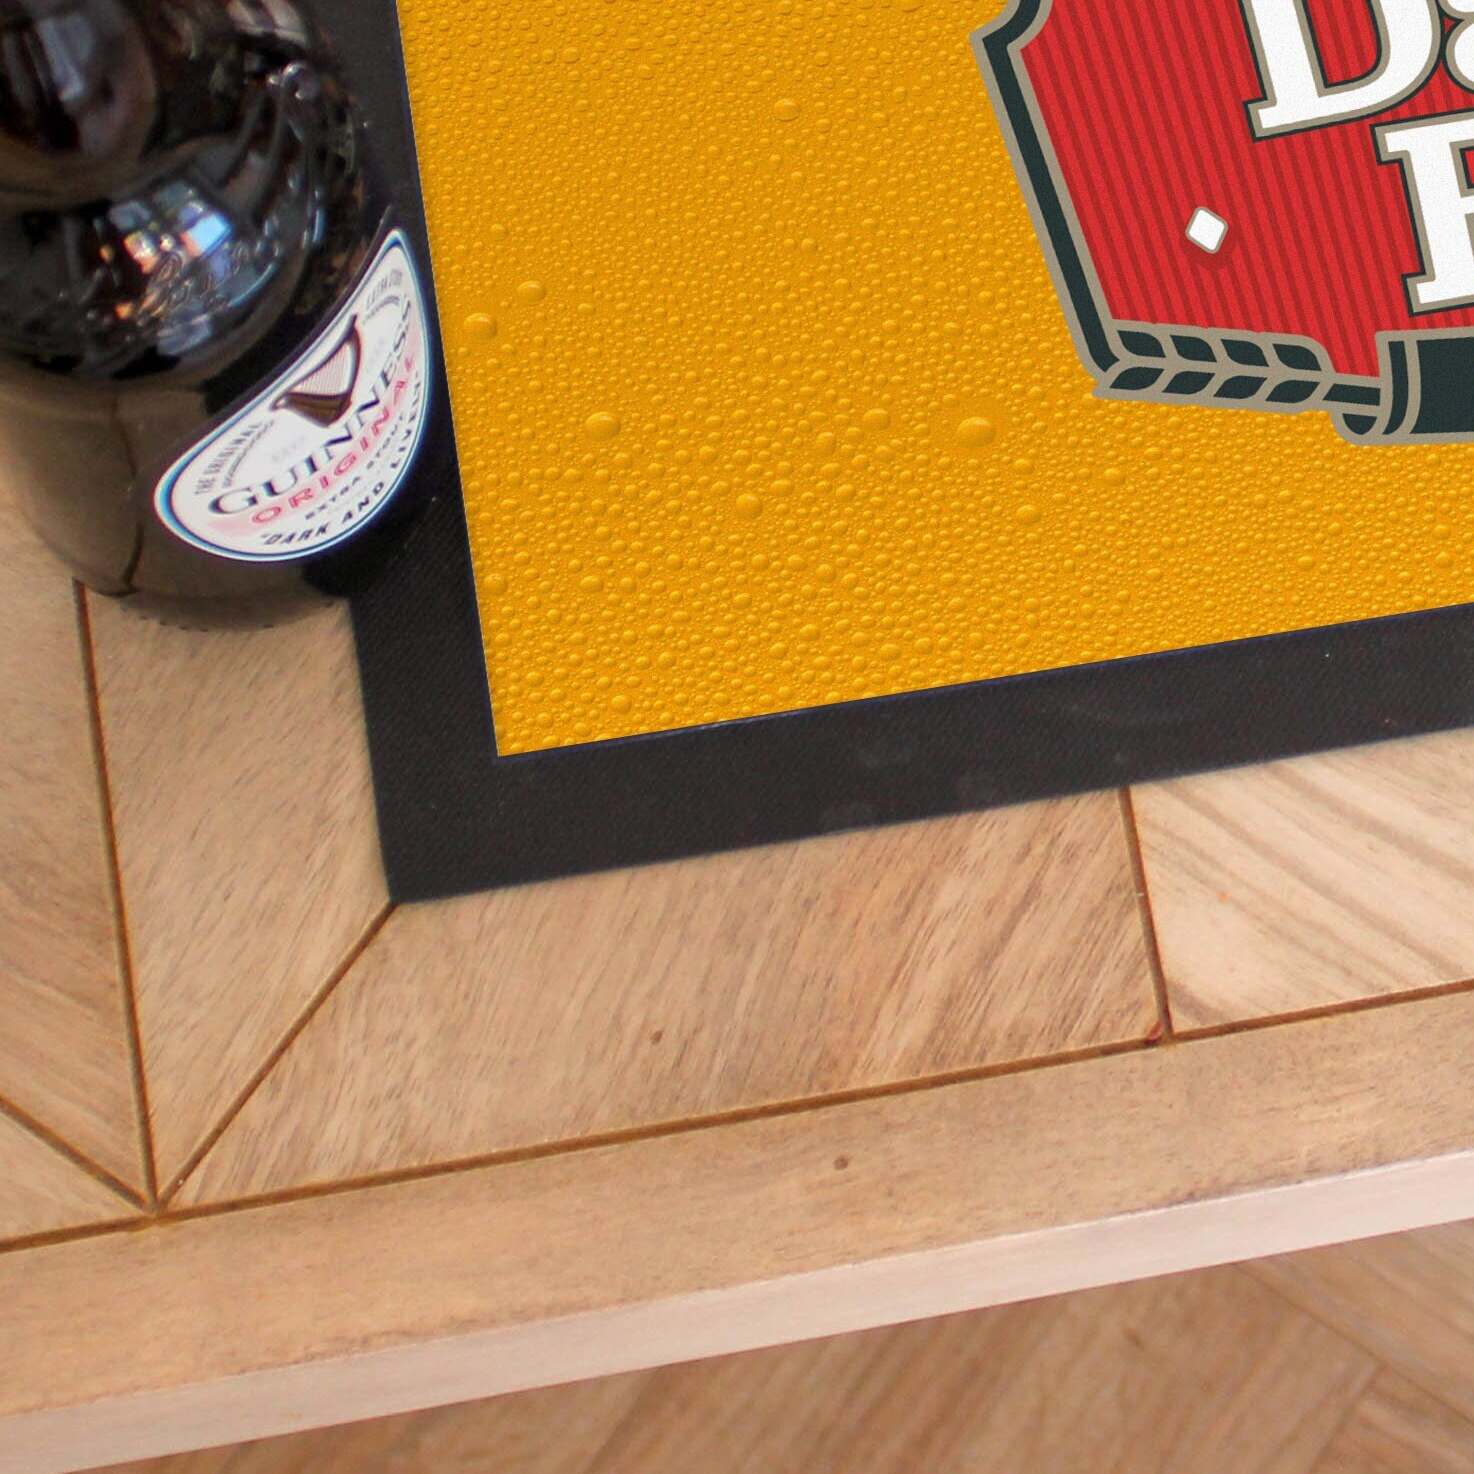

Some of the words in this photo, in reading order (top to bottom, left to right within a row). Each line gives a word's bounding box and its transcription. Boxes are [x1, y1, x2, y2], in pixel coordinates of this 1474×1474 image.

[208, 293, 411, 514] GUINNESS
[305, 475, 361, 520] EXTRA
[342, 481, 385, 524] AND
